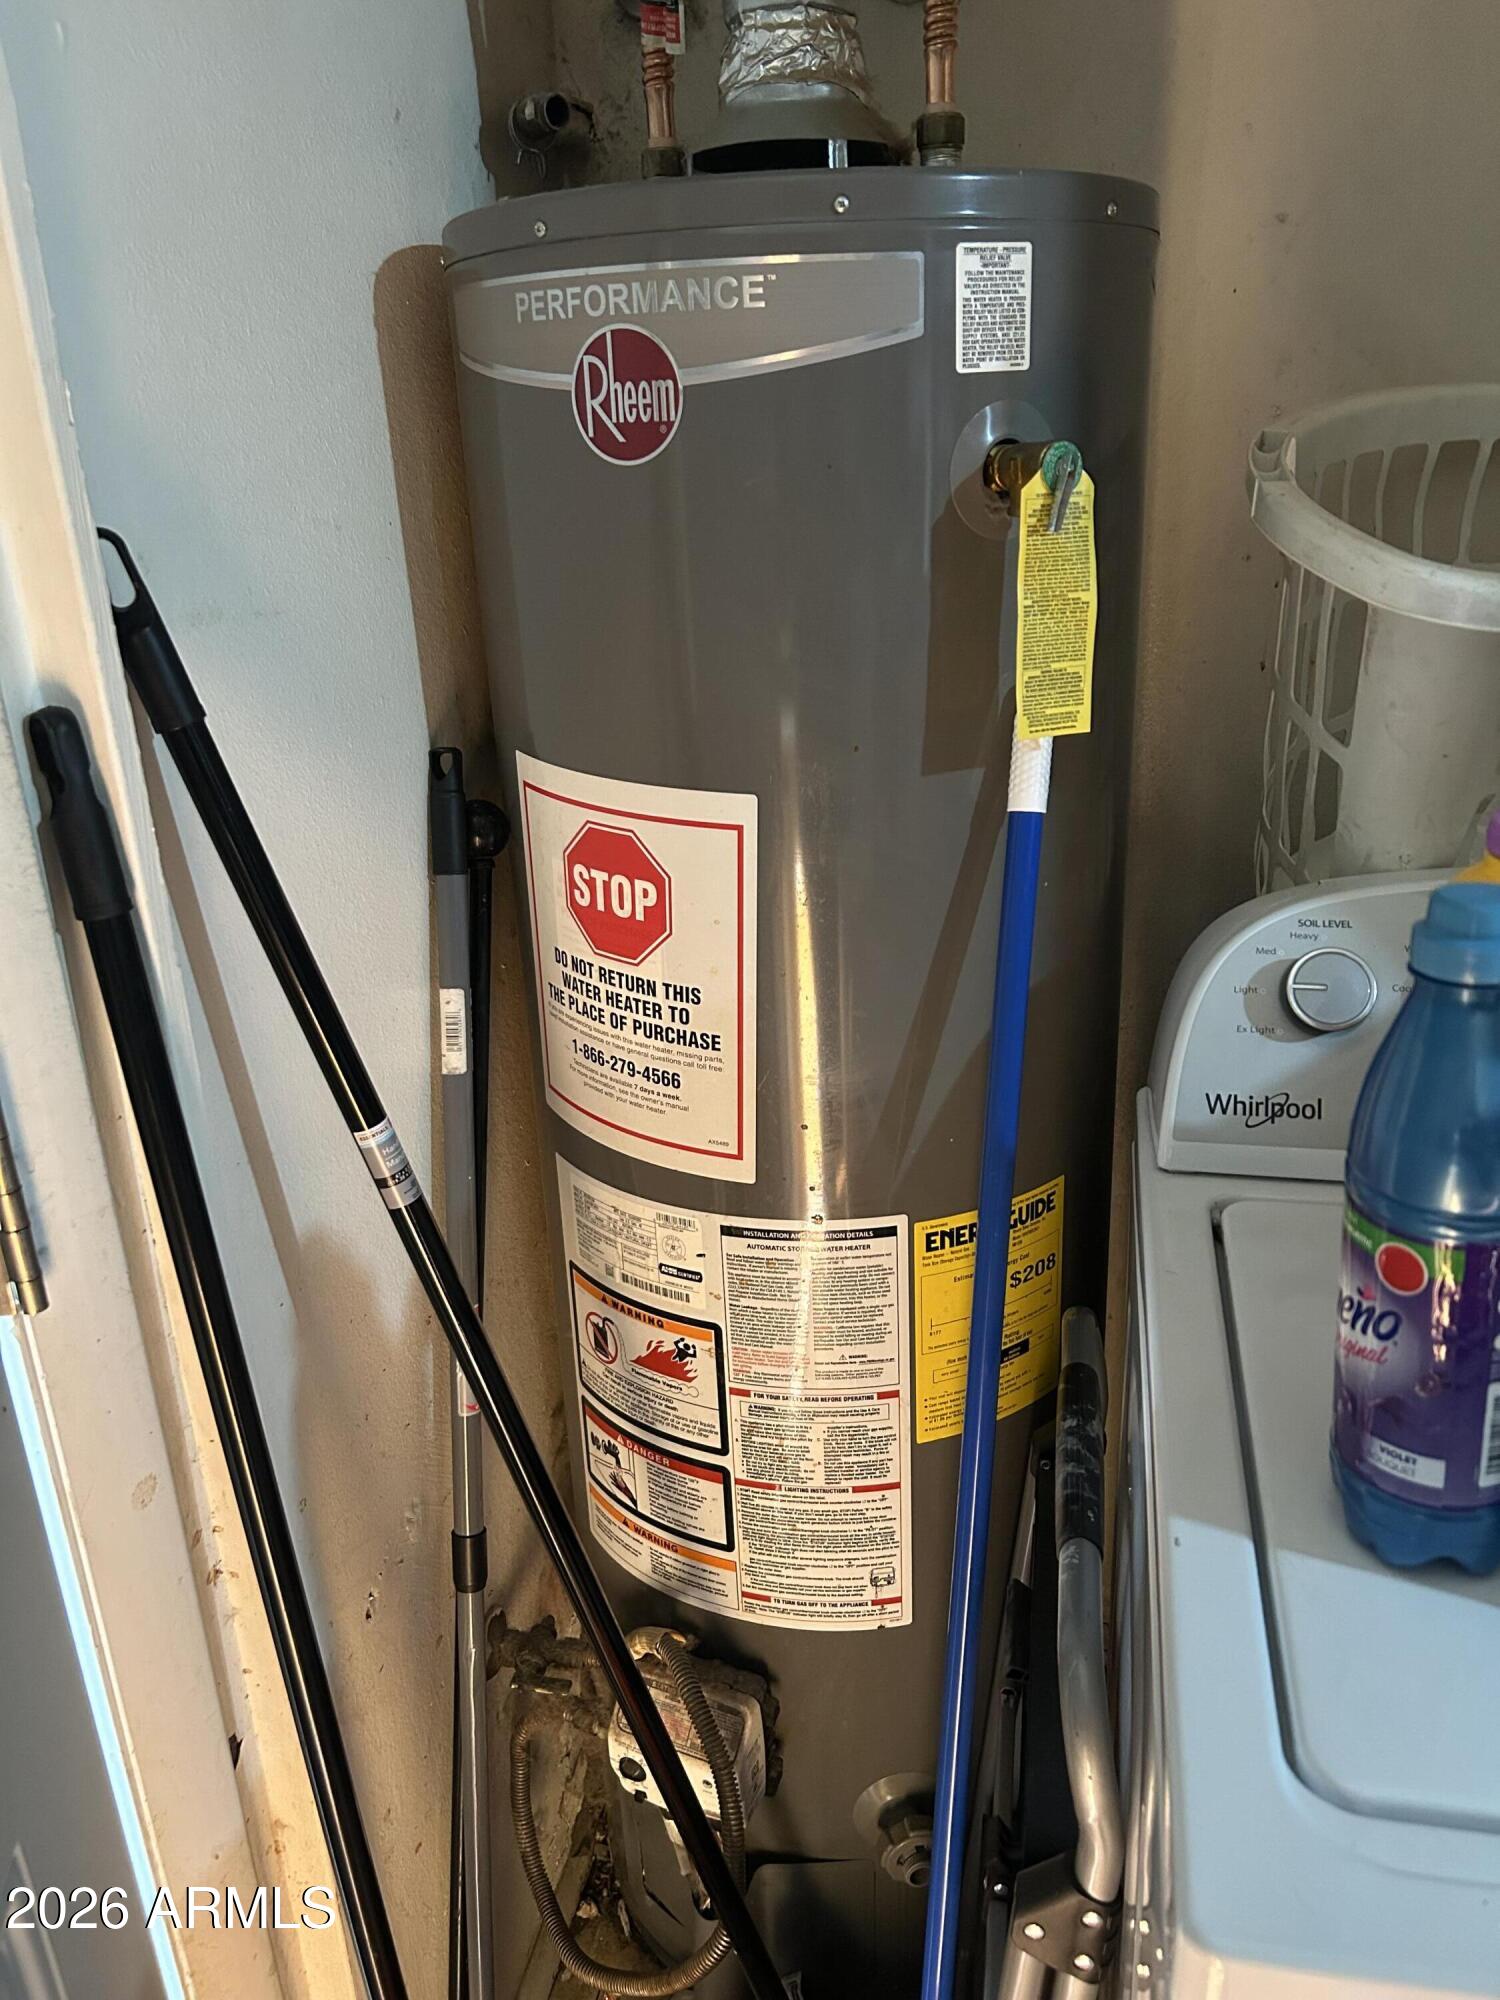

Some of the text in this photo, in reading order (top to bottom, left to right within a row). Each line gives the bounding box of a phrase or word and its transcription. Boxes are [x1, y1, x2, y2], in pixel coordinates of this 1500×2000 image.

[583, 331, 675, 442] Rheem
[573, 864, 657, 921] STOP
[1290, 932, 1318, 942] Heavy
[1298, 919, 1352, 928] SOIL LEVEL
[1256, 947, 1276, 955] Med
[554, 946, 702, 1006] DO NOT RETURN THIS
[562, 970, 690, 1026] WATER HEATER TO
[1234, 986, 1258, 995] Light
[548, 982, 722, 1052] THE PLACE OF PURCHASE
[1236, 1026, 1276, 1036] Ex Light
[610, 1032, 622, 1041] with
[622, 1036, 634, 1044] this
[634, 1040, 652, 1050] water
[652, 1043, 676, 1056] heater,
[676, 1049, 704, 1062] missing
[704, 1054, 726, 1065] parts,
[612, 1042, 626, 1051] have
[626, 1046, 650, 1058] general
[650, 1053, 682, 1066] questions
[683, 1060, 695, 1068] call
[696, 1062, 706, 1071] toll
[708, 1064, 724, 1072] free
[572, 1038, 681, 1089] 1-866-279-4566
[604, 1089, 616, 1098] with
[616, 1094, 628, 1104] your
[628, 1098, 646, 1110] water
[630, 1090, 640, 1100] the
[640, 1094, 664, 1108] owner's
[666, 1102, 690, 1112] manual
[639, 1084, 655, 1096] days
[662, 1092, 682, 1102] week.
[1205, 1092, 1322, 1128] Whirlpool
[360, 1126, 388, 1142] ESSNTIALS
[744, 1230, 790, 1240] INSTALLATION
[847, 1230, 874, 1238] DETAILS
[747, 1243, 786, 1252] AUTOMATIC
[845, 1244, 870, 1252] HEATER
[926, 1223, 978, 1253] ENER
[954, 1274, 974, 1283] Estima
[1020, 1252, 1030, 1262] Cost
[1010, 1252, 1056, 1289] $208
[612, 1299, 664, 1329] WARNING
[632, 1368, 682, 1392] Flammable Vapors
[652, 1392, 674, 1404] HAZARD
[626, 1440, 670, 1467] DANGER
[1380, 1444, 1417, 1466] VIOLET
[634, 1524, 678, 1552] WARNING
